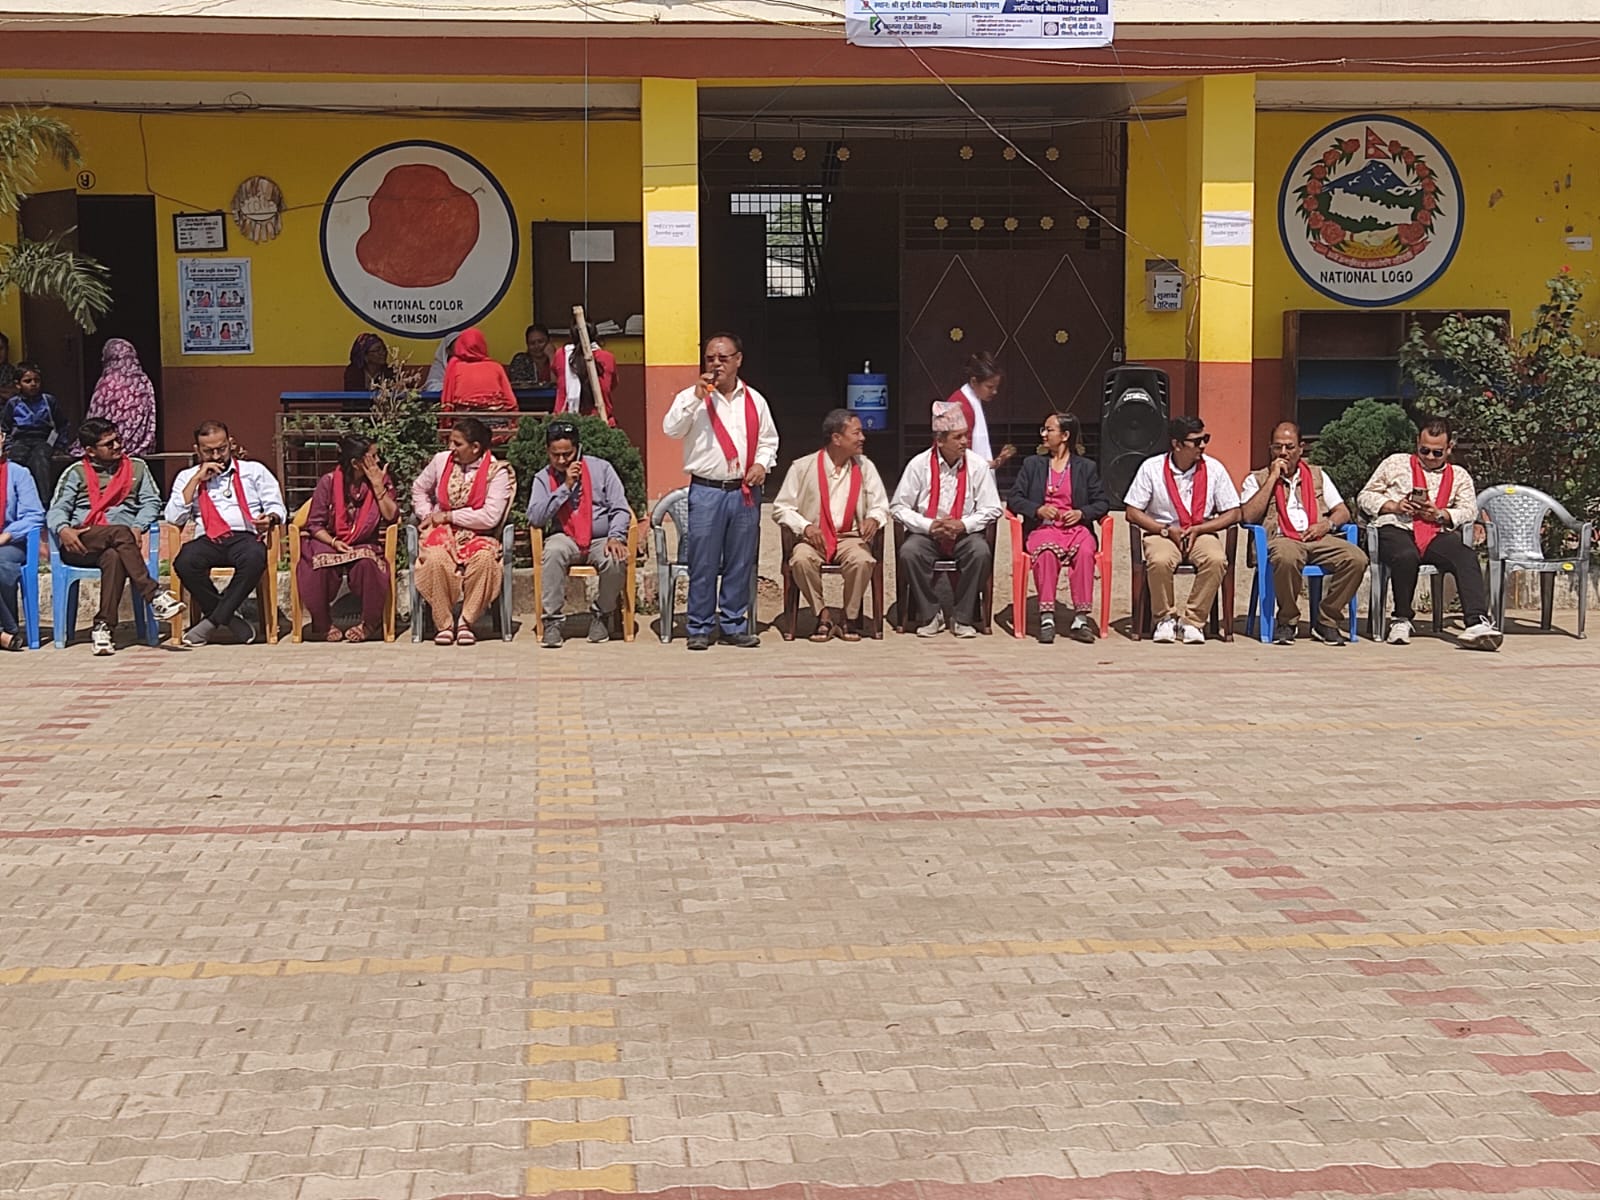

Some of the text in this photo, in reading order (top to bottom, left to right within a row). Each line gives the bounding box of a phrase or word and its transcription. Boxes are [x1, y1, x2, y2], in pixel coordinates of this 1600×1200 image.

[1320, 270, 1413, 284] NATIONAL LOGO
[373, 299, 464, 311] NATIONAL COLOR
[390, 313, 438, 324] CRIMSON
